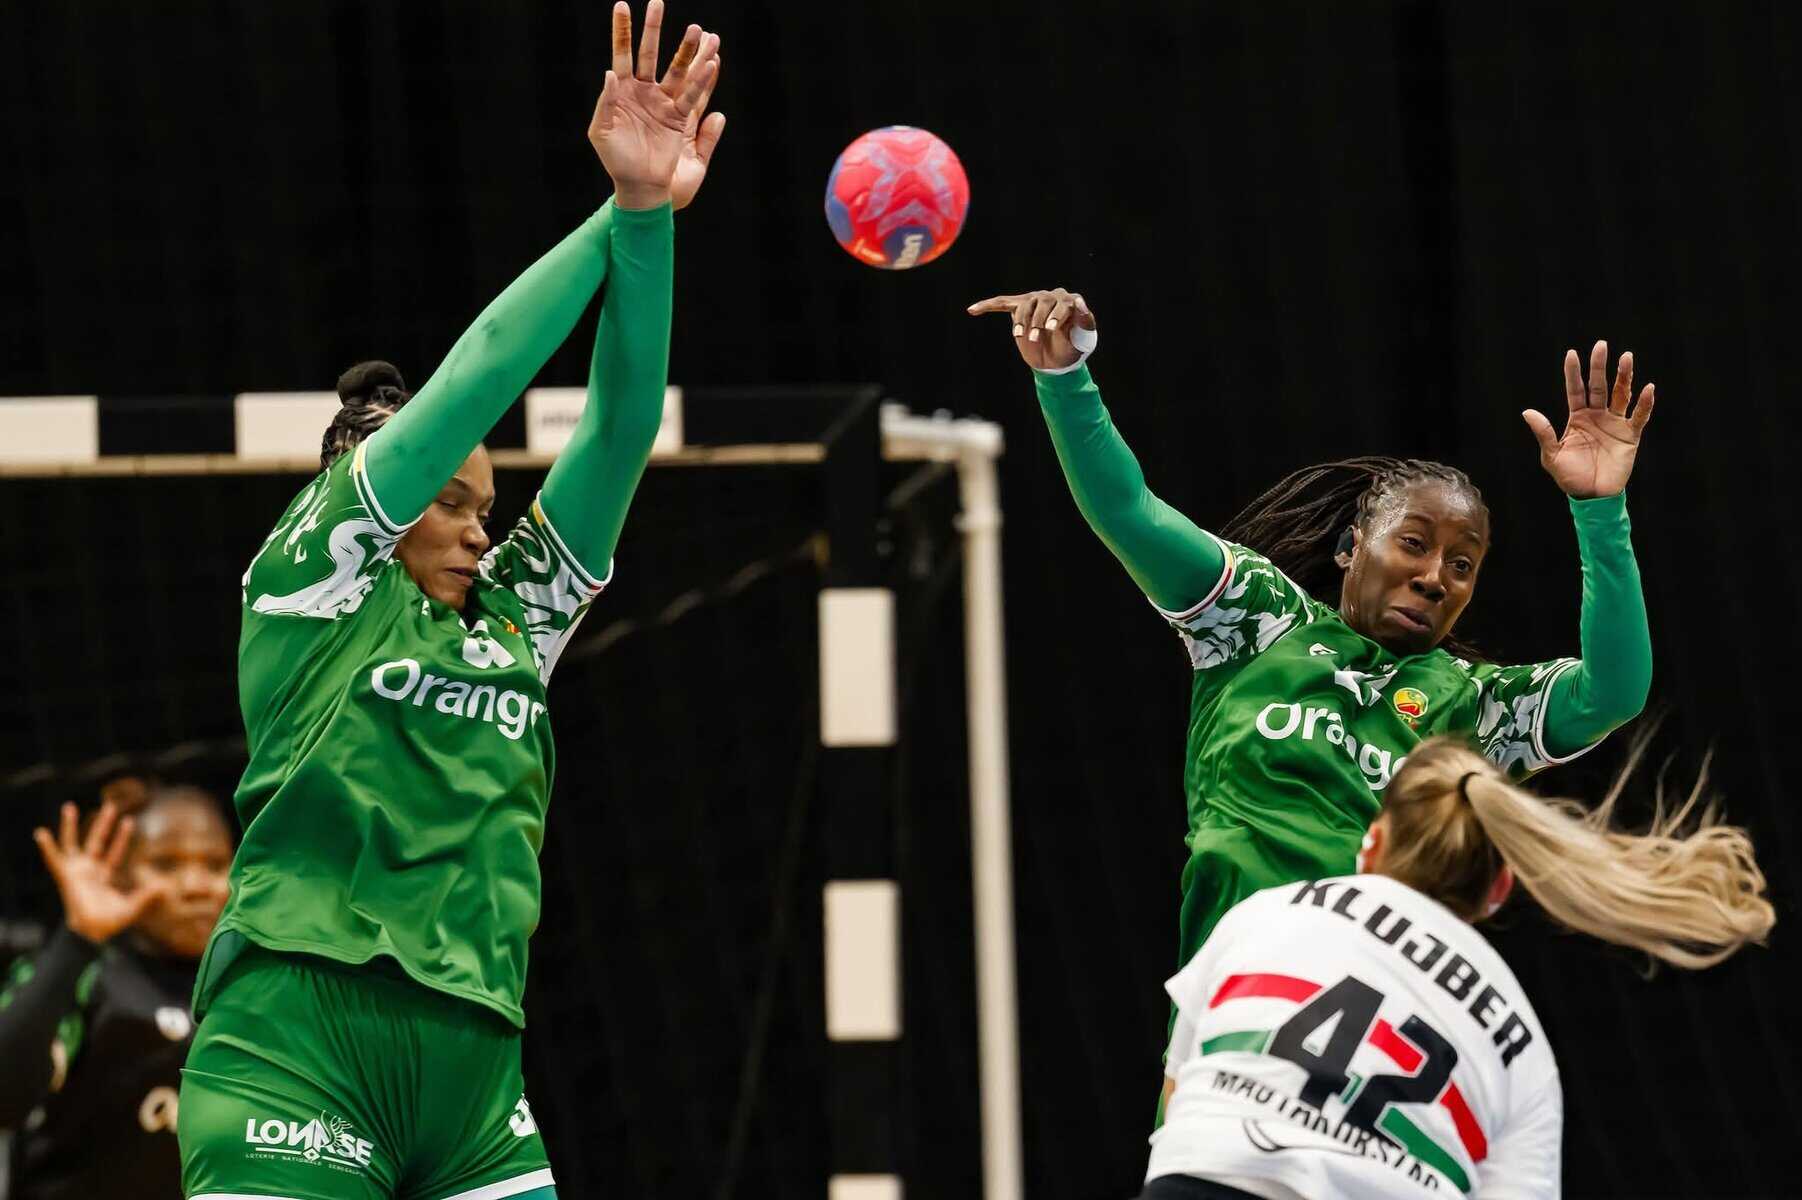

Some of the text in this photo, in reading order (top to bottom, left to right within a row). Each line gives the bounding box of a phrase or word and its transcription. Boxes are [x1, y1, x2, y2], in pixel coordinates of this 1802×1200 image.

[1256, 702, 1407, 791] Orag
[1290, 879, 1533, 1069] KLUJBER
[1268, 975, 1458, 1150] 42
